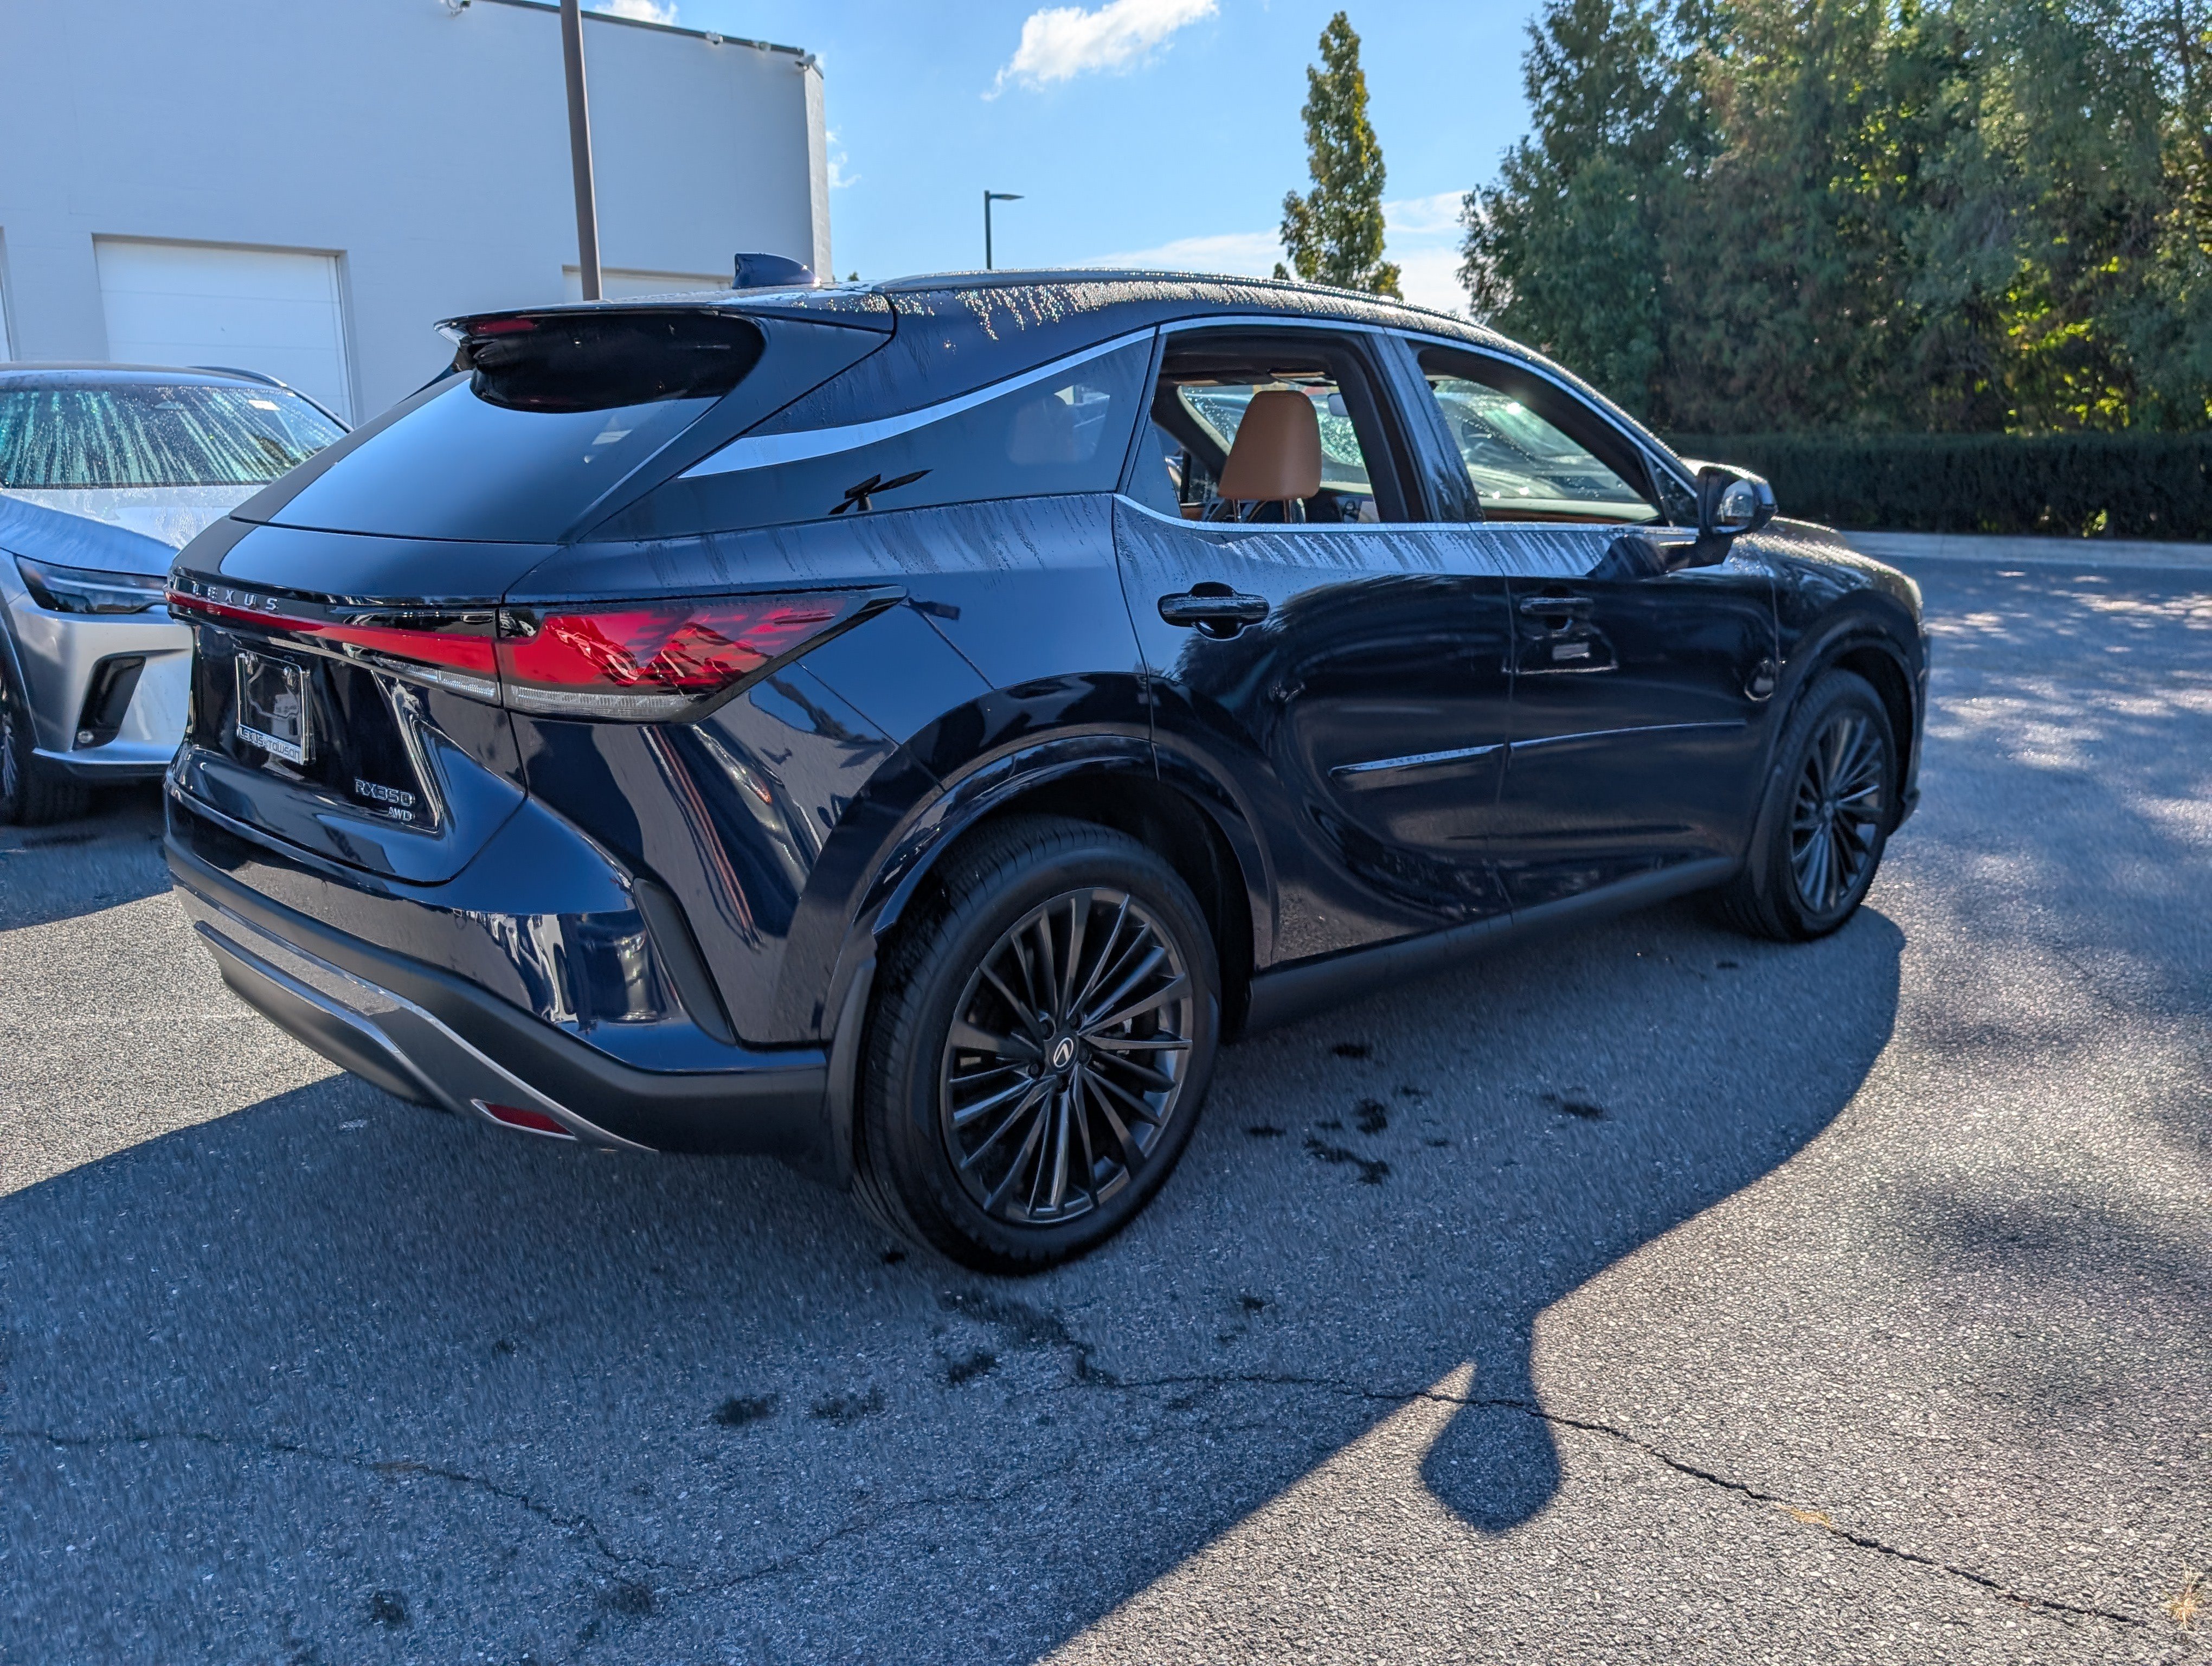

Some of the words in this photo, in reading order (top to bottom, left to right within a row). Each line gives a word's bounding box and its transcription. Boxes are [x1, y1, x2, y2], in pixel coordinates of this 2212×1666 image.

[192, 584, 278, 610] LEXUS
[240, 727, 263, 746] LEXUS
[388, 806, 413, 821] AWD
